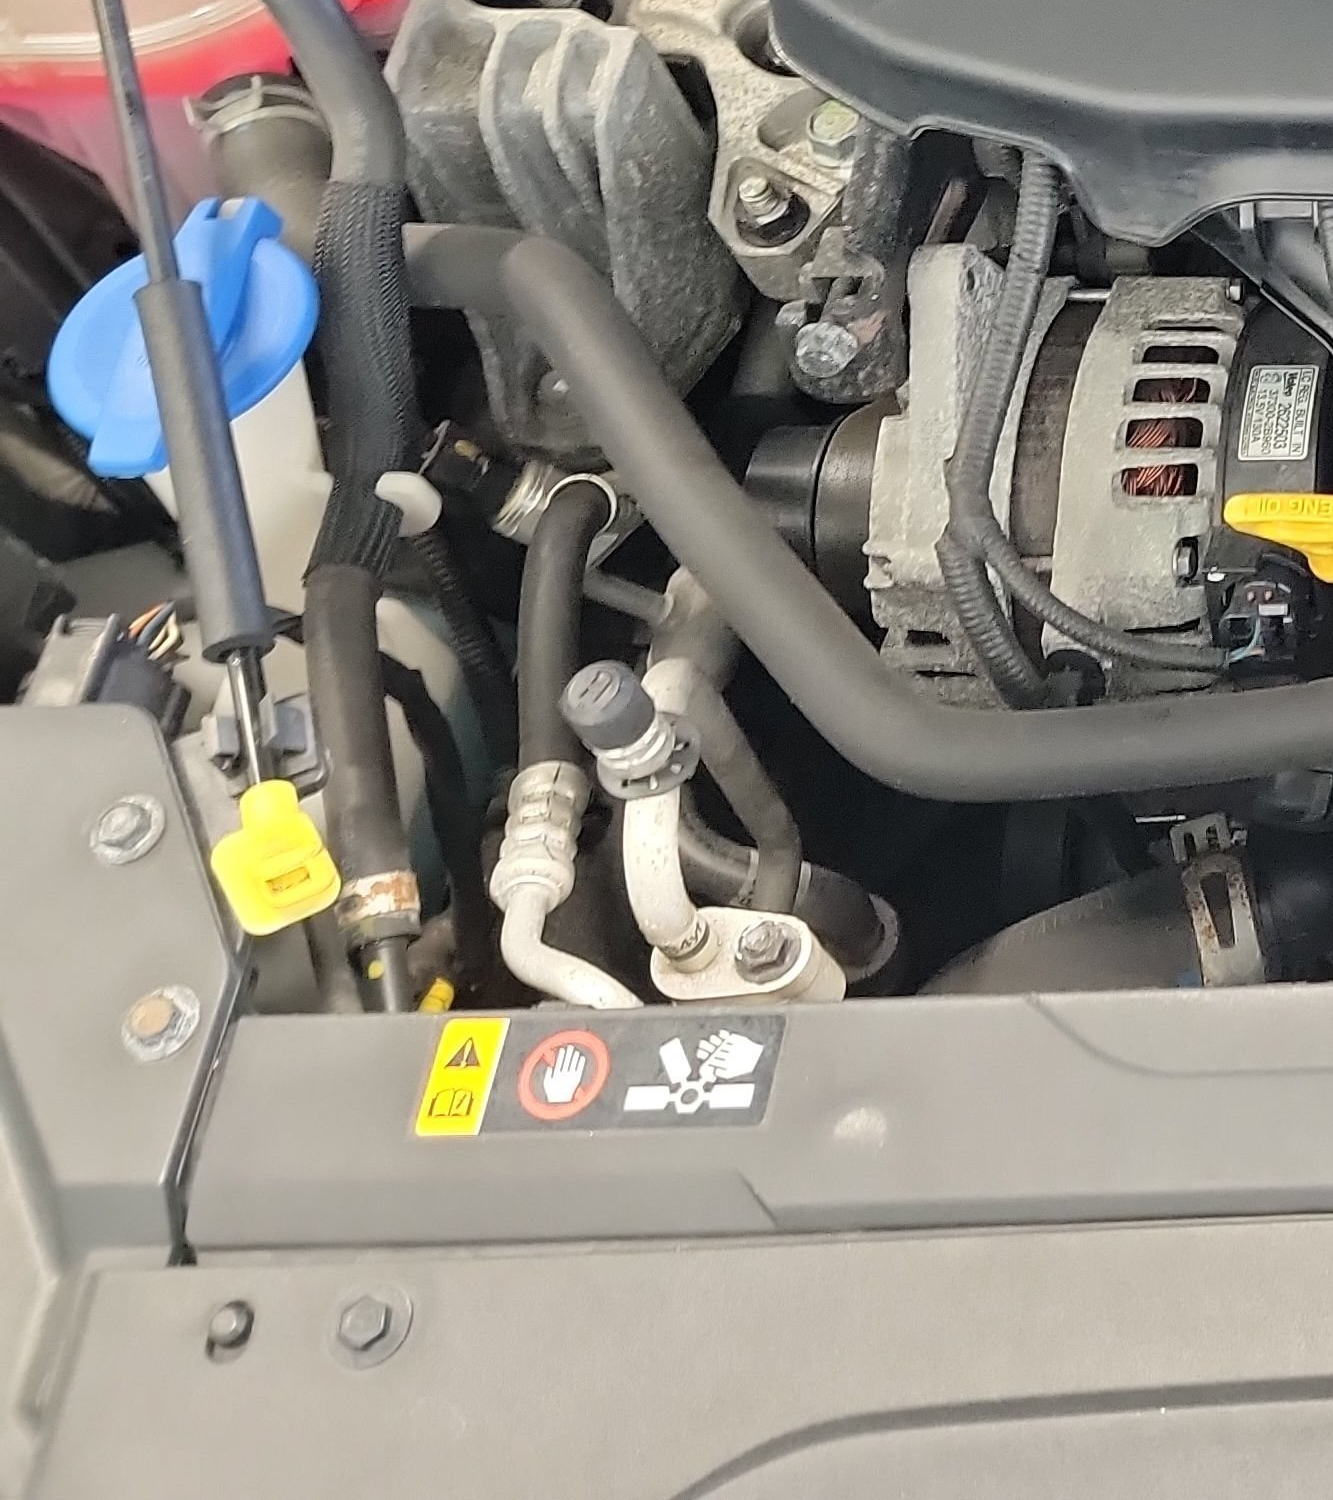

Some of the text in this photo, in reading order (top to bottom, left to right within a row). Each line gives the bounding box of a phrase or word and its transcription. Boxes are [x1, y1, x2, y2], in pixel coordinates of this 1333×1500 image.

[1255, 389, 1267, 415] 13.5V
[1273, 403, 1292, 449] 2622503
[1293, 409, 1306, 436] BUILT
[1292, 443, 1302, 453] IN
[1251, 498, 1333, 519] ENG OIL
